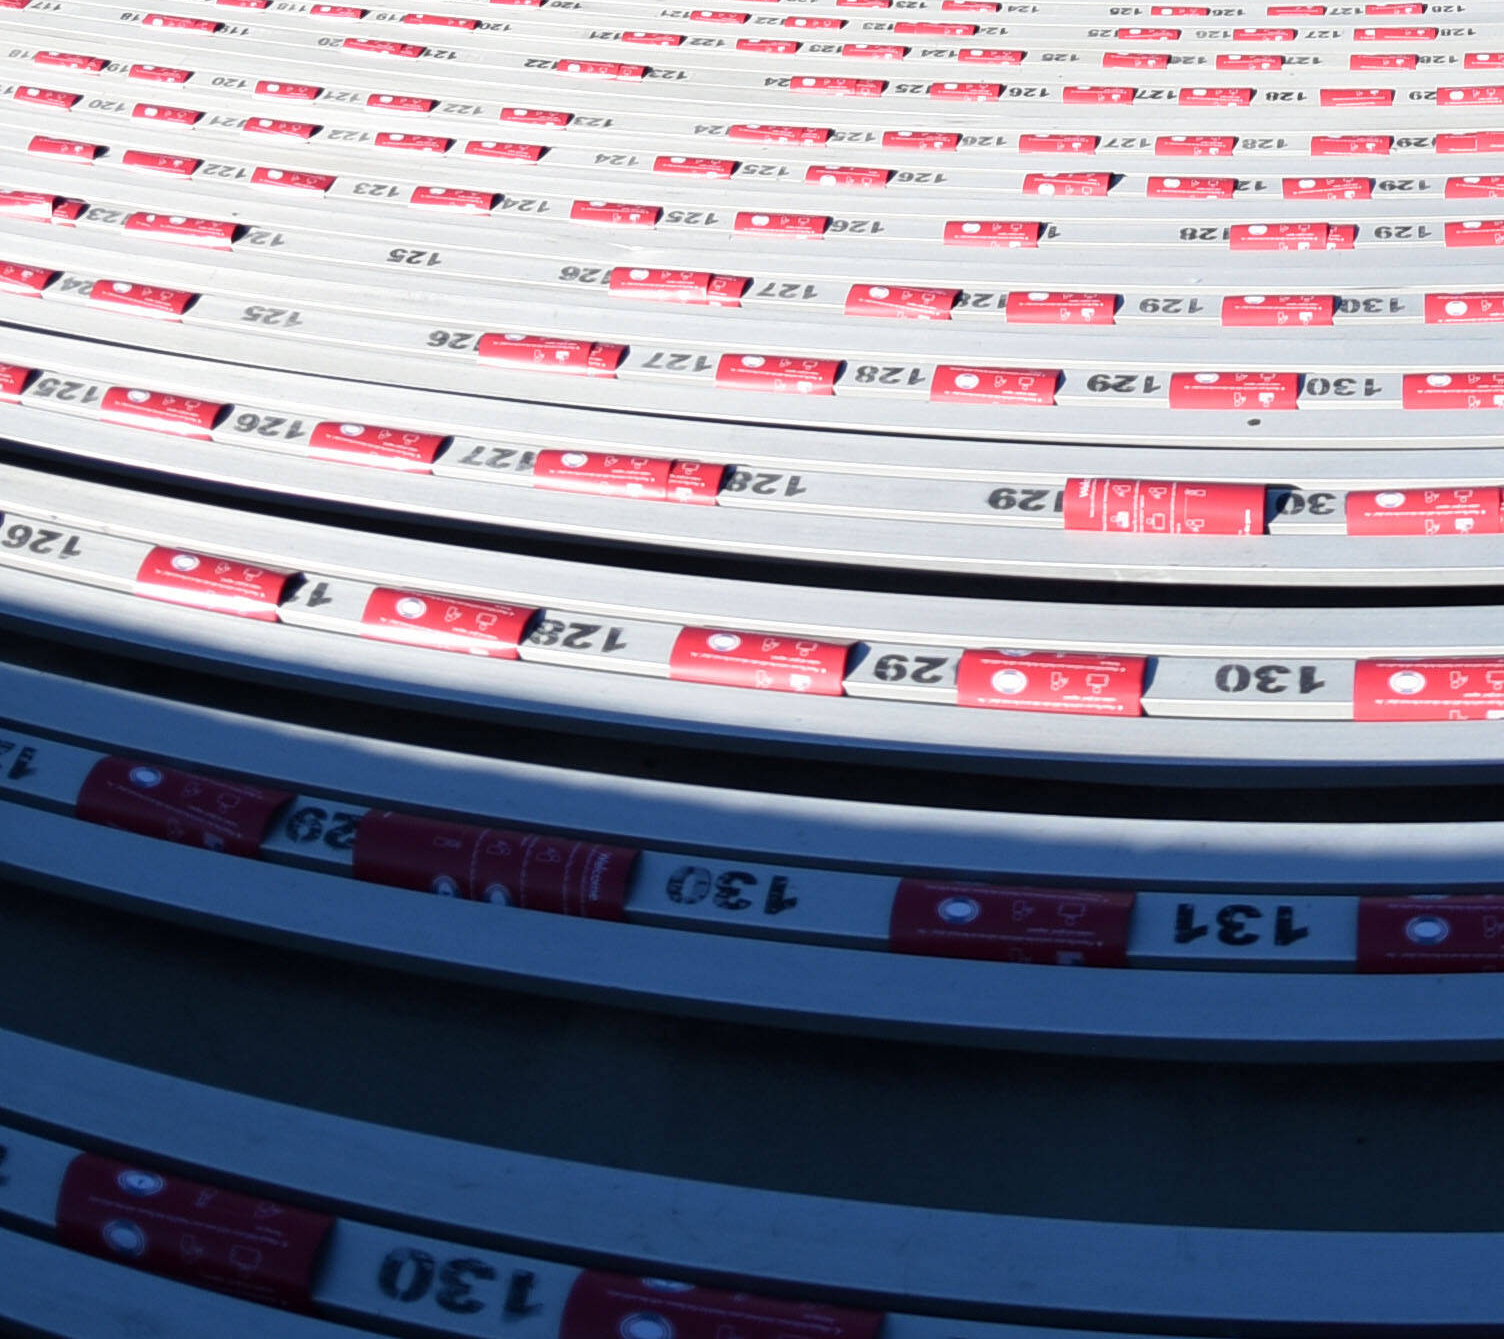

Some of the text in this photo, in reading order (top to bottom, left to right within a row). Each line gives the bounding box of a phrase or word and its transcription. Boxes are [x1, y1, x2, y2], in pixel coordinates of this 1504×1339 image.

[202, 163, 247, 178] 122
[741, 163, 791, 176] 125
[352, 184, 400, 197] 123
[1378, 179, 1431, 191] 129
[664, 211, 719, 226] 125
[1375, 226, 1432, 238] 129
[387, 249, 442, 265] 125
[758, 282, 818, 299] 127
[241, 305, 304, 326] 125
[1139, 298, 1204, 314] 129
[642, 352, 713, 371] 127
[855, 367, 926, 385] 128
[1087, 374, 1162, 393] 129
[35, 377, 101, 403] 125
[1306, 377, 1384, 396] 130
[234, 413, 305, 438] 126
[0, 524, 84, 560] 126
[1214, 664, 1326, 695] 130
[664, 866, 801, 917] 130
[1172, 903, 1312, 951] 131
[377, 1247, 546, 1323] 130
